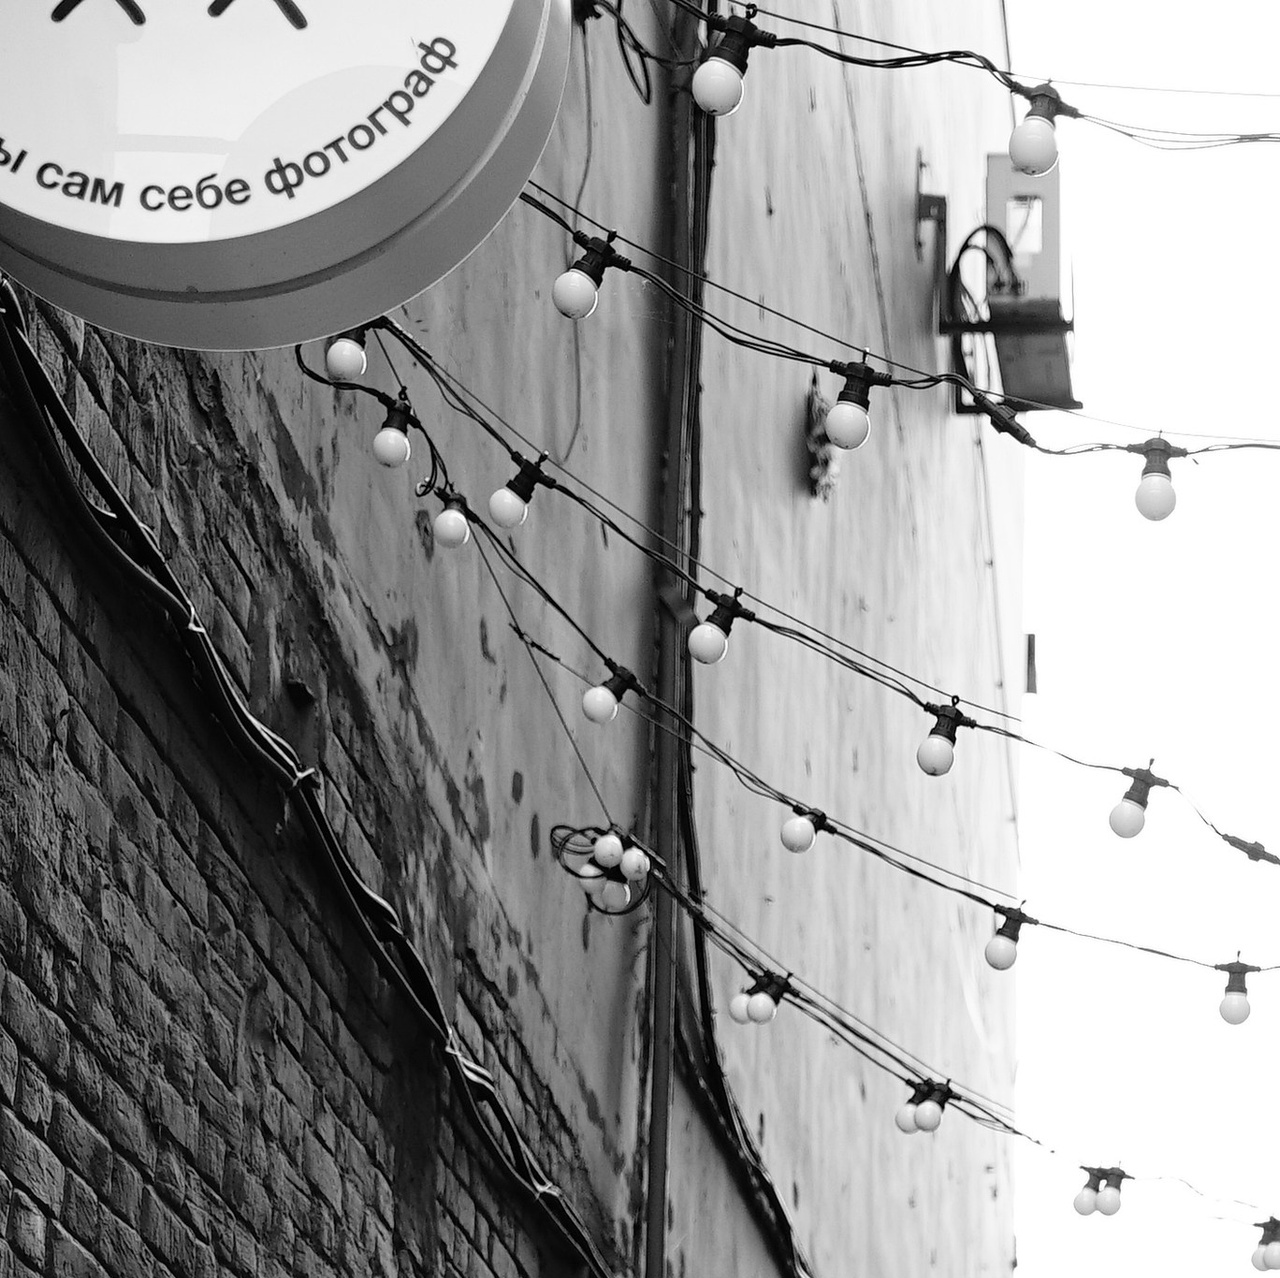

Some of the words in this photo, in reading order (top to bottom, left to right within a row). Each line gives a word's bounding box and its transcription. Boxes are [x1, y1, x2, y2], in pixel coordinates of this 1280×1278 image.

[36, 161, 124, 208] сам
[139, 172, 252, 212] себе
[264, 35, 459, 200] фотограф
